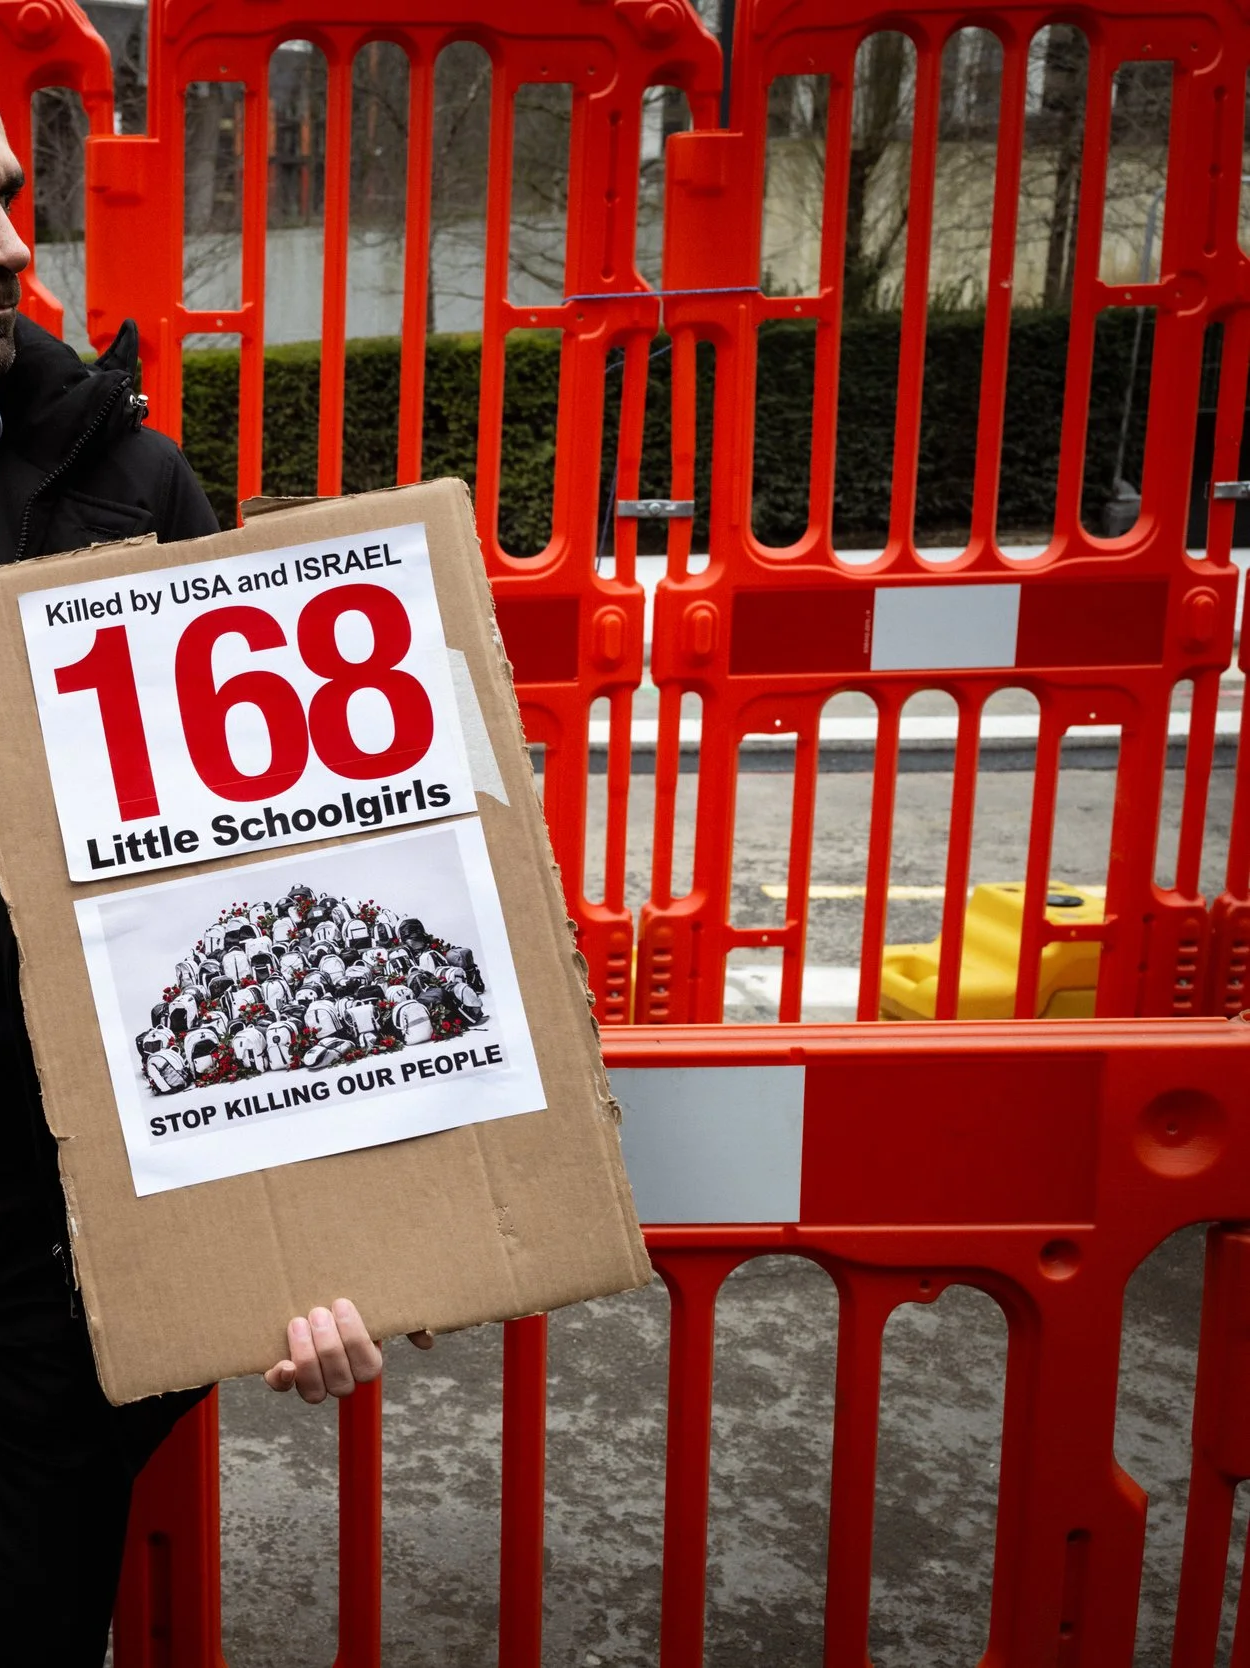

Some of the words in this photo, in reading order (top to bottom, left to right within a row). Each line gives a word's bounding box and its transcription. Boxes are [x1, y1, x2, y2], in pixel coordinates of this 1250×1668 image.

[46, 592, 123, 626] Killed
[130, 589, 162, 615] by
[170, 574, 232, 604] USA
[237, 563, 288, 593] and
[295, 543, 402, 582] ISRAEL
[54, 583, 434, 822] 168
[86, 825, 199, 870] Little
[211, 779, 451, 846] Schoolgirls
[150, 1105, 217, 1137] STOP
[225, 1081, 330, 1120] KILLING
[337, 1067, 395, 1095] OUR
[402, 1044, 503, 1082] PEOPLE
